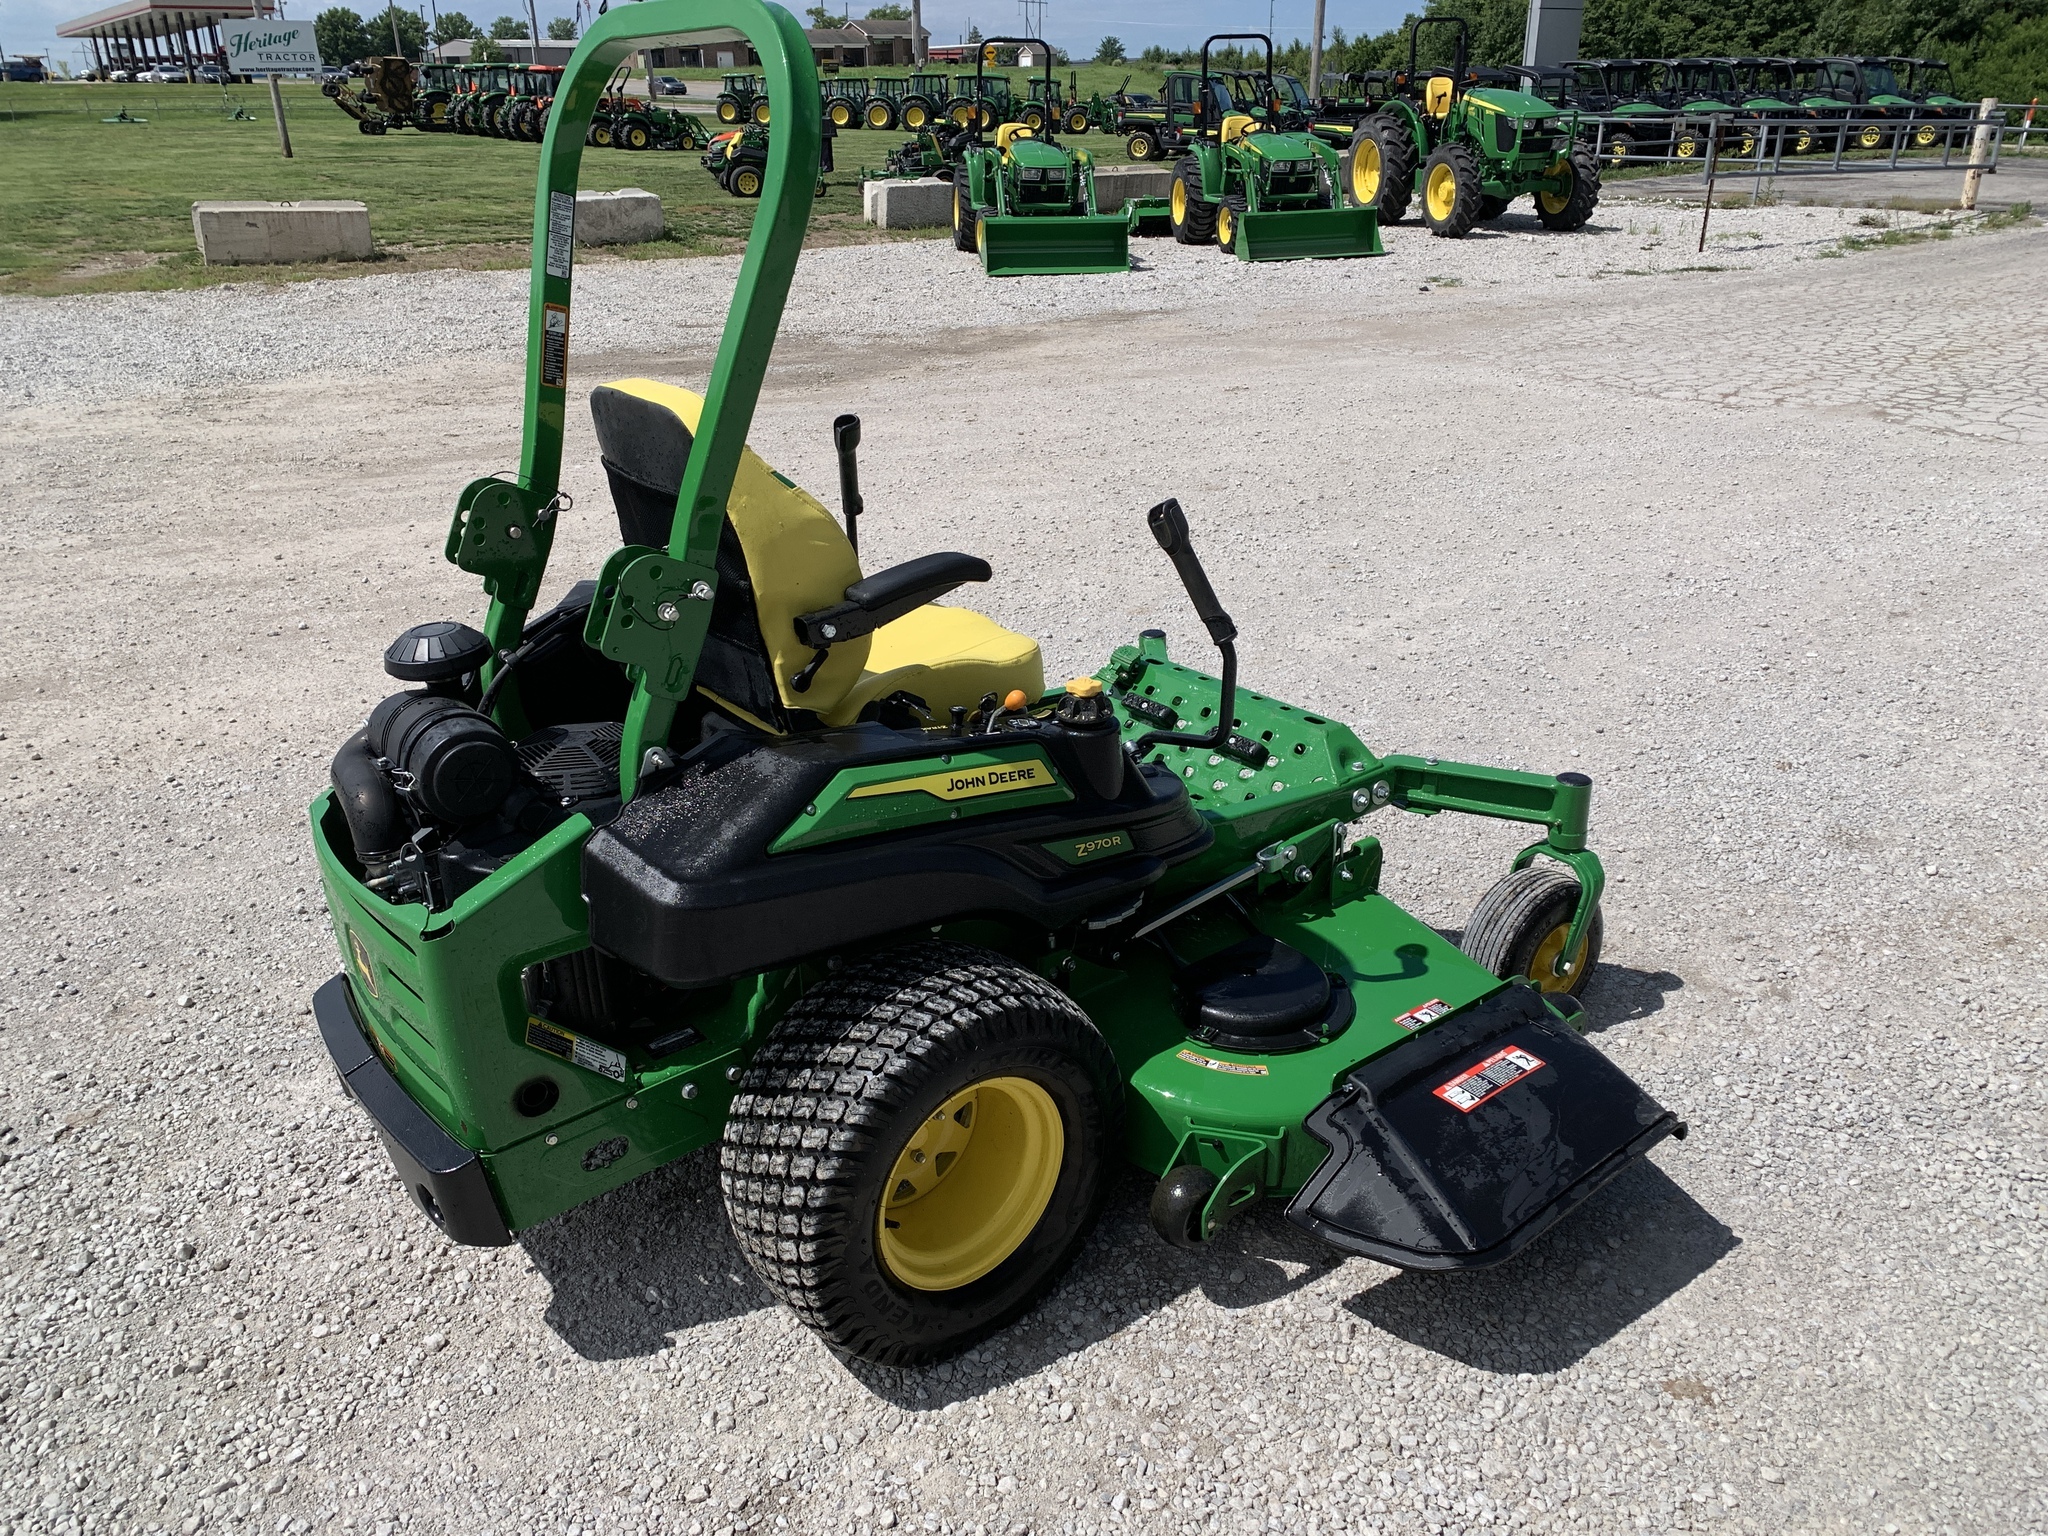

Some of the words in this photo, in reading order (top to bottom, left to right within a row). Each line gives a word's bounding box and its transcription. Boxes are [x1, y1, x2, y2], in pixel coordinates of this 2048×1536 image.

[230, 29, 299, 58] Heritage
[257, 53, 316, 62] TRACTOR
[946, 775, 986, 793] JOHN
[988, 767, 1036, 786] DEERE
[1075, 835, 1122, 858] Z970R
[541, 1022, 565, 1037] CAUTION
[1447, 1073, 1470, 1087] DANGER
[858, 1254, 929, 1335] KENDA
